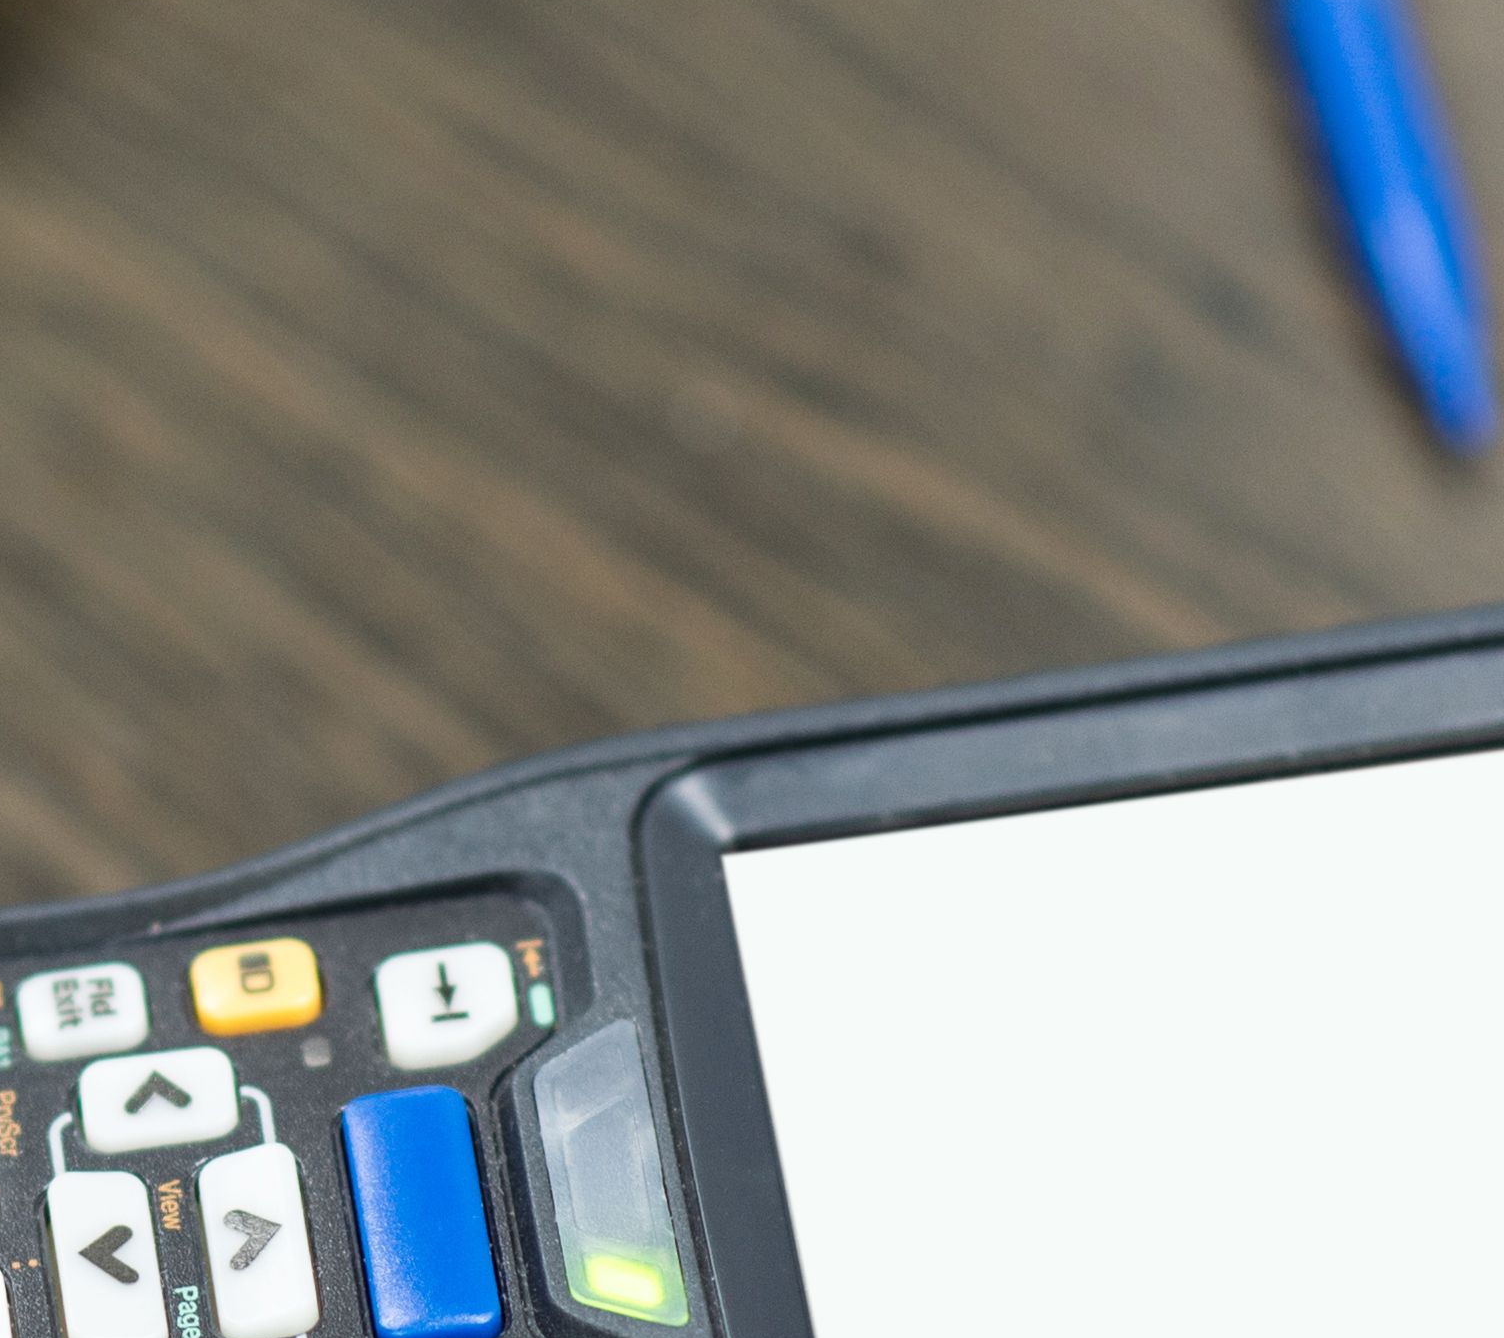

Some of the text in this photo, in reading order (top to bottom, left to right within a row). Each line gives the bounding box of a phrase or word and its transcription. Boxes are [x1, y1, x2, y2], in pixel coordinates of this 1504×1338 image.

[52, 978, 82, 1029] Exit
[86, 977, 115, 1017] Fld
[158, 1178, 183, 1231] View
